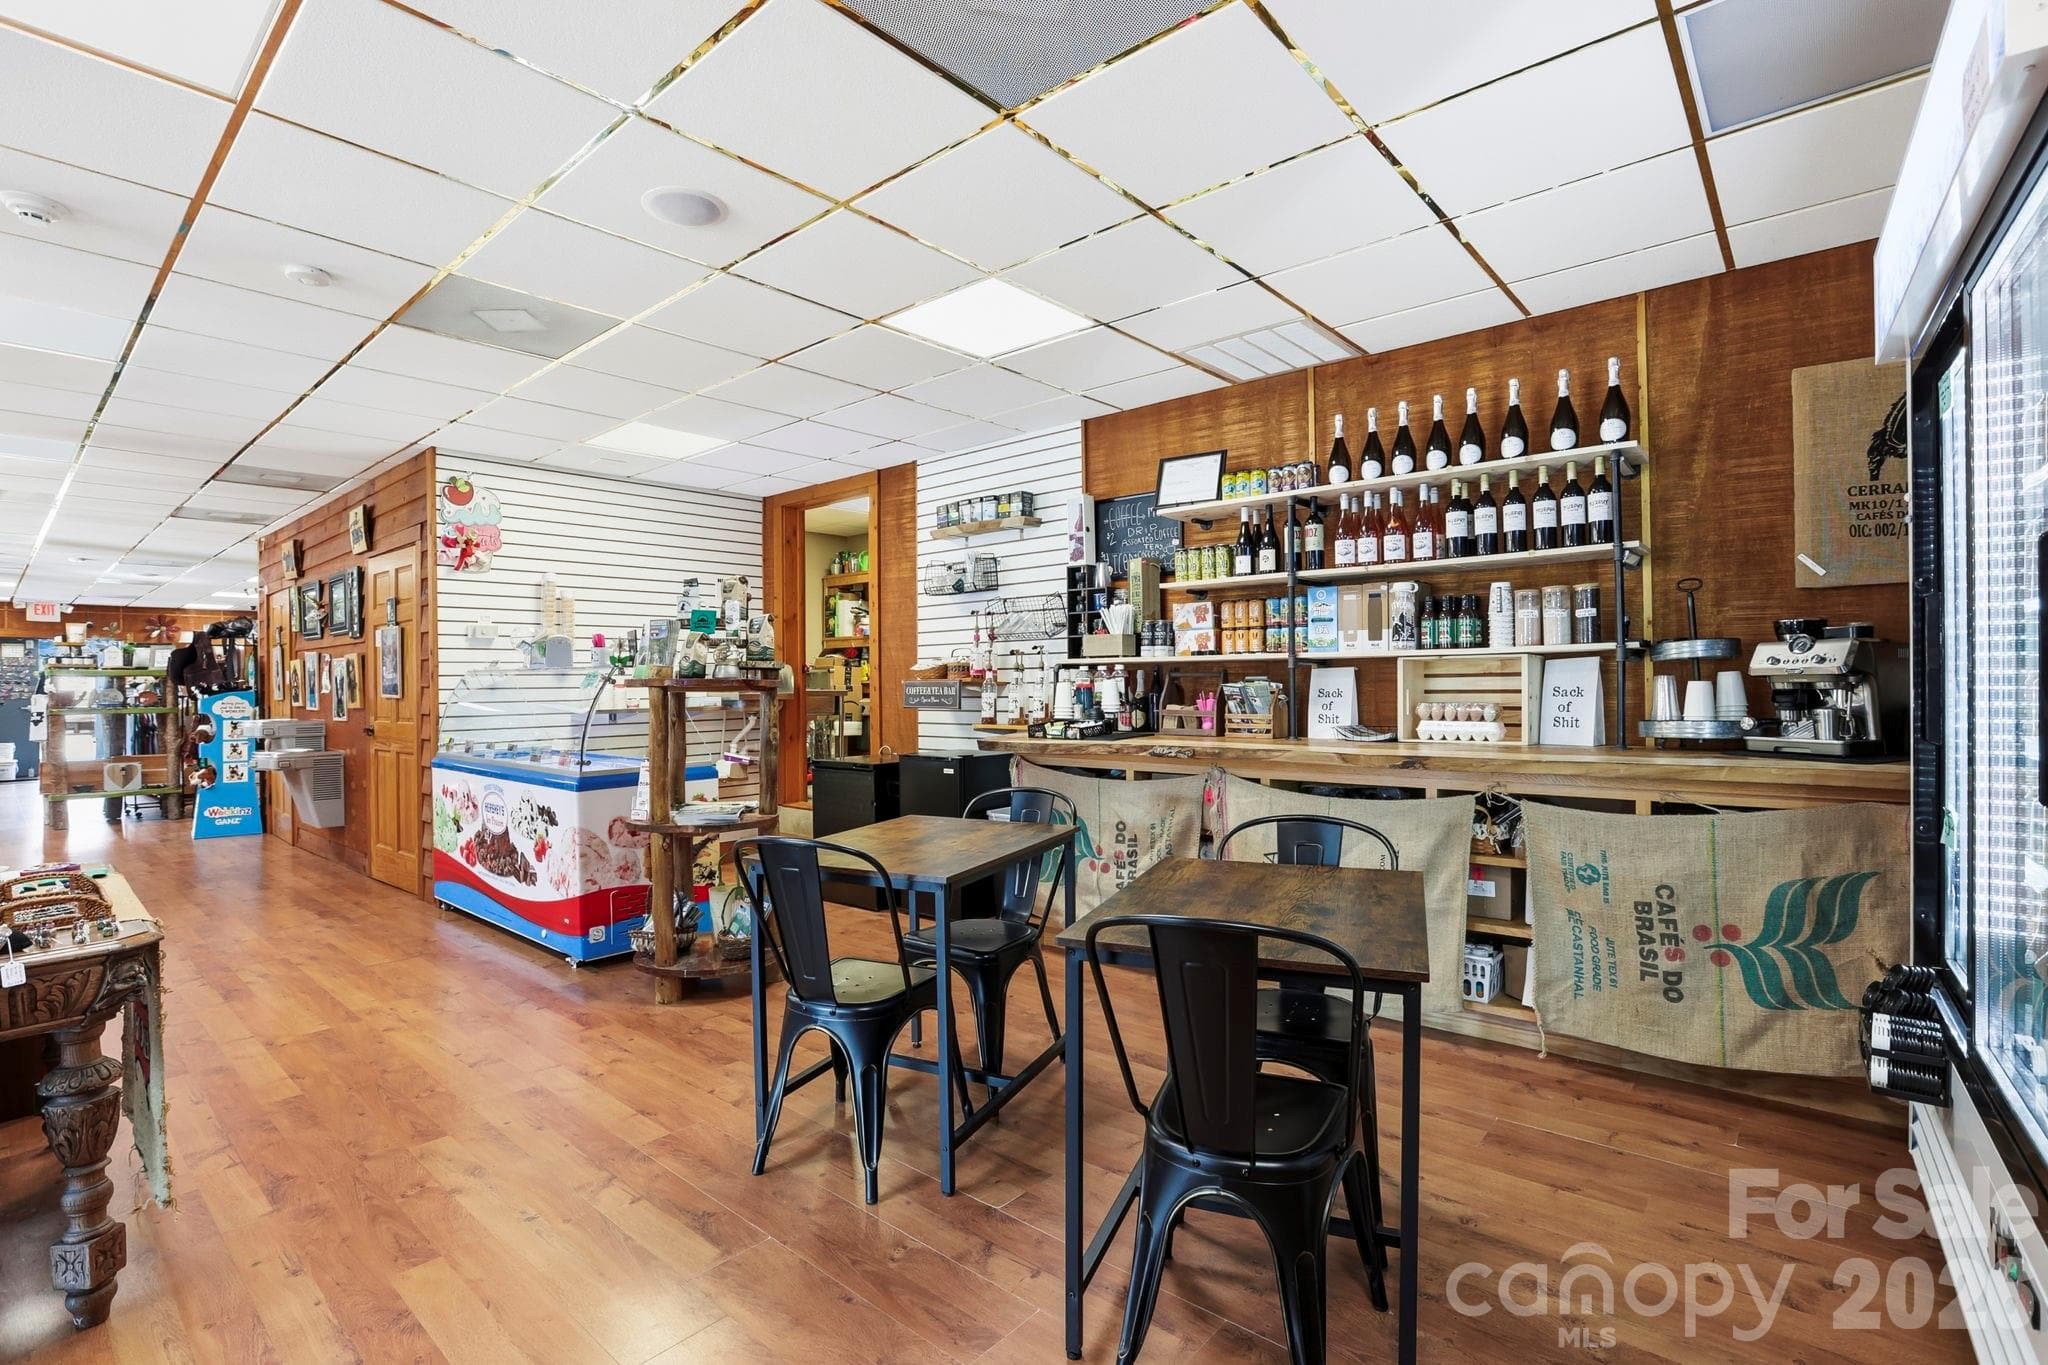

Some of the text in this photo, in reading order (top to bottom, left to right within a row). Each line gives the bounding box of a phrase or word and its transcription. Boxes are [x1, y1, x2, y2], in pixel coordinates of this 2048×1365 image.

[1847, 483, 1908, 496] CERRA
[1856, 509, 1894, 520] CAFÉS
[1849, 523, 1872, 538] OIC:
[34, 603, 56, 616] EXIT
[1317, 688, 1343, 698] Sack
[1552, 686, 1584, 698] Sack
[1321, 701, 1334, 711] of
[1557, 701, 1573, 712] of
[1318, 714, 1340, 724] Shit
[1553, 716, 1580, 728] Shit
[1113, 820, 1127, 890] AFÉS DO
[1126, 834, 1138, 881] RASIL
[1633, 901, 1660, 982] BRASIL
[1654, 884, 1686, 1004] CAFÉS DO
[1571, 925, 1584, 1000] CASTANHAL
[1587, 925, 1602, 992] FOOD GRADE
